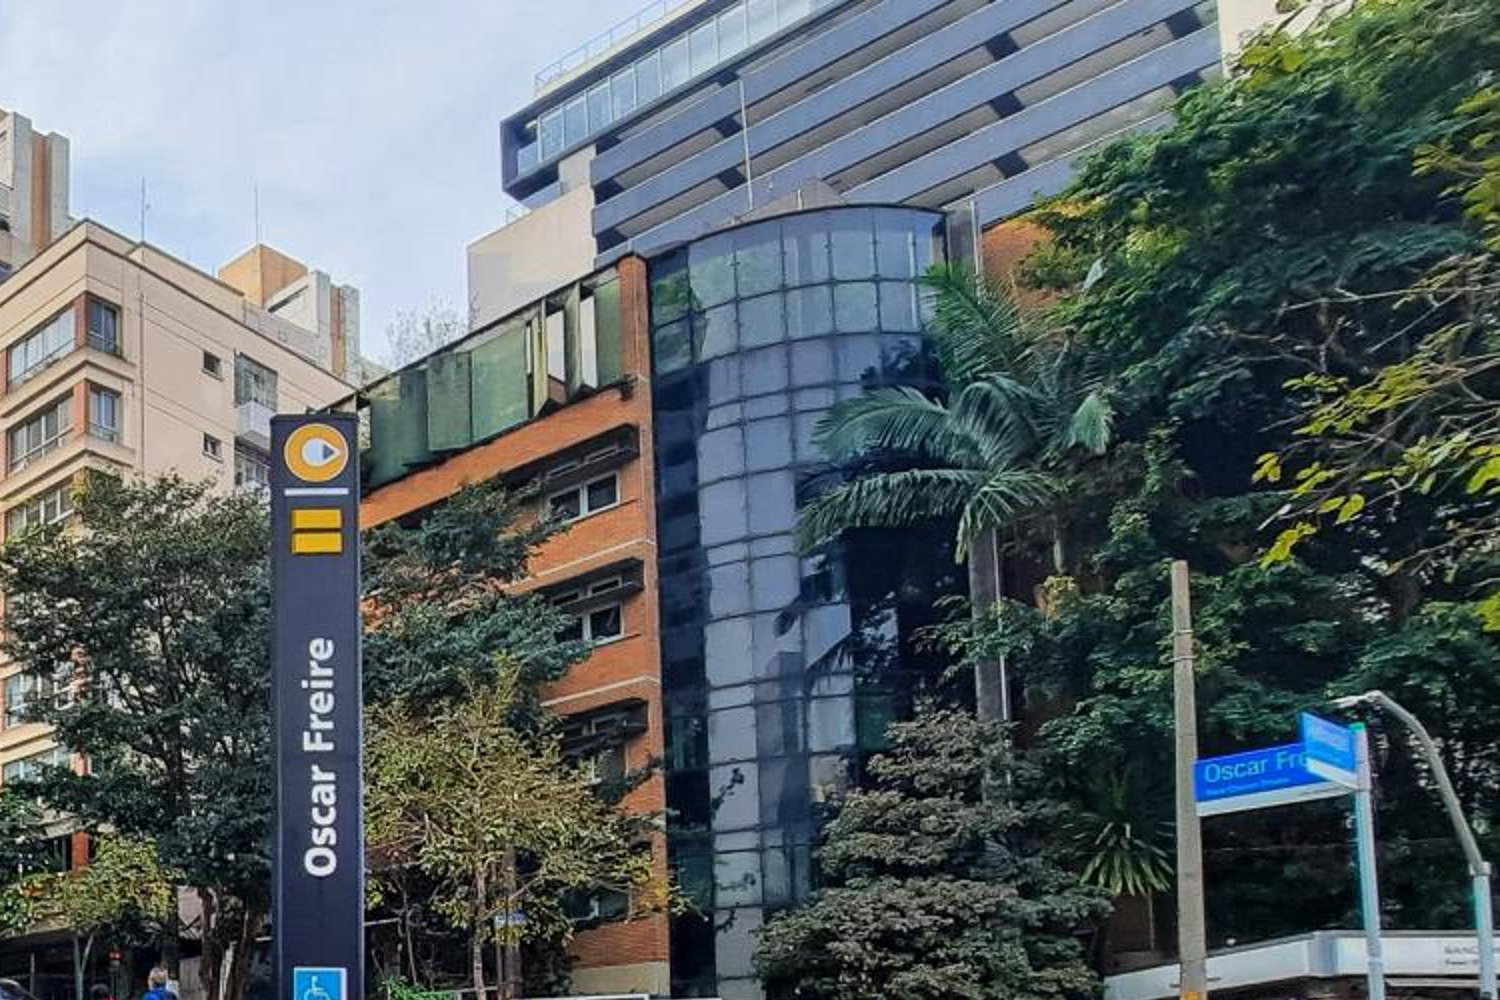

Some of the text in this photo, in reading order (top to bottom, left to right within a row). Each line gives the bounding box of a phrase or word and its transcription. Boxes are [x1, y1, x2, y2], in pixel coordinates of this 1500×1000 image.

[301, 637, 337, 877] Oscar Freire
[1204, 750, 1310, 782] Oscar Fre
